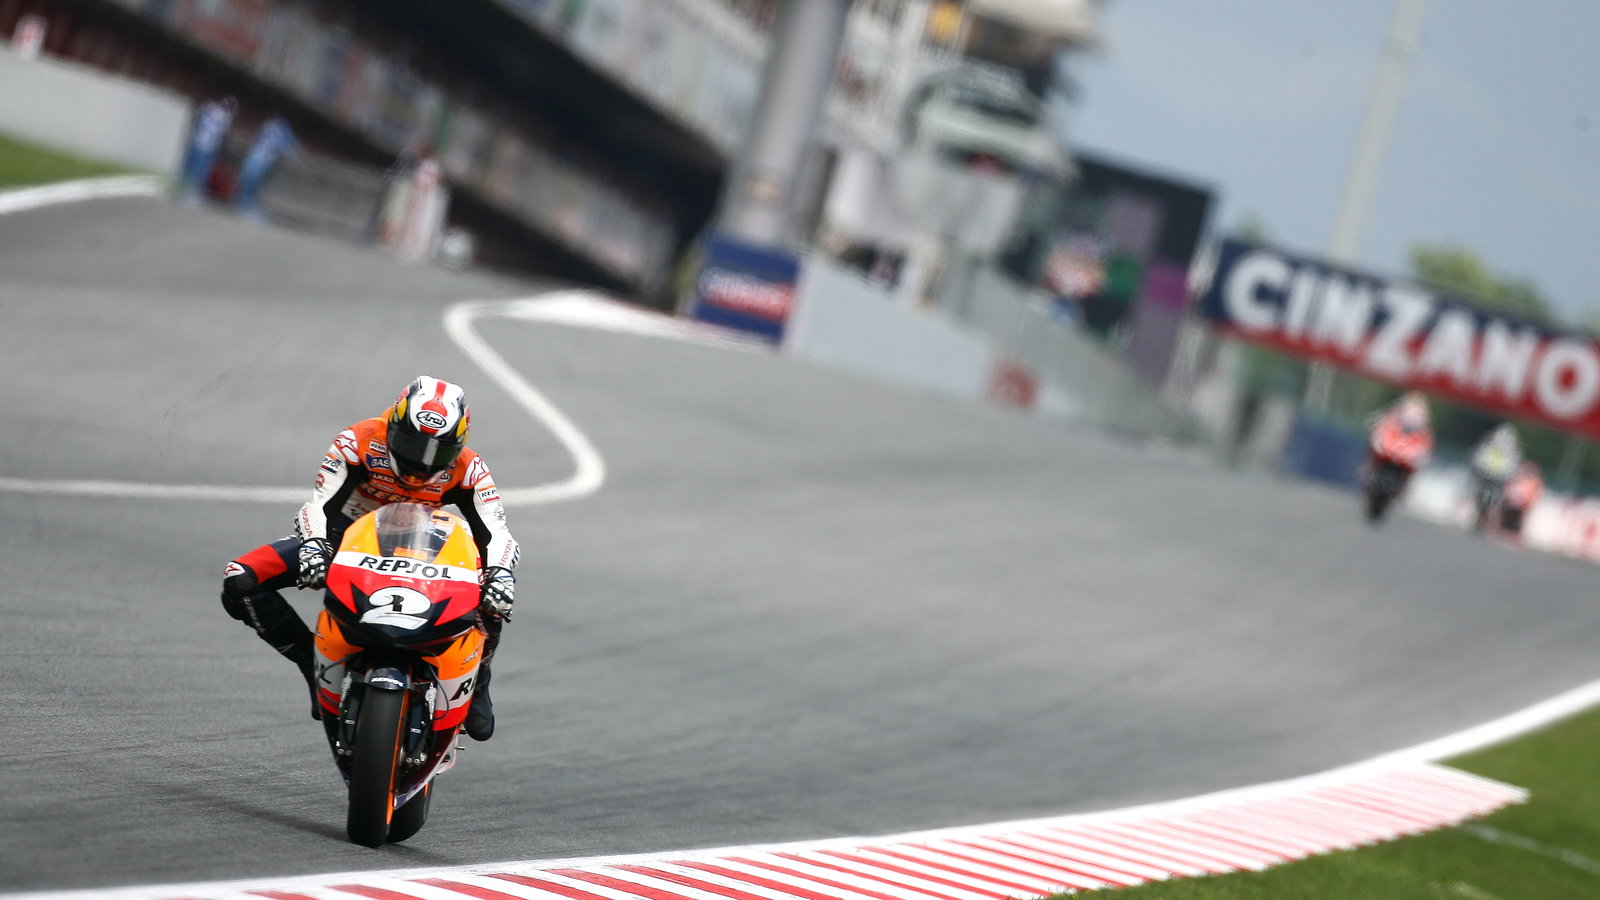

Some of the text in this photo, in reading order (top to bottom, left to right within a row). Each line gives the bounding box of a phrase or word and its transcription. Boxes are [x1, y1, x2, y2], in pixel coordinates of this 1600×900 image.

[1223, 253, 1600, 419] CINZANO
[358, 555, 452, 580] REPSOL
[358, 586, 432, 631] 2
